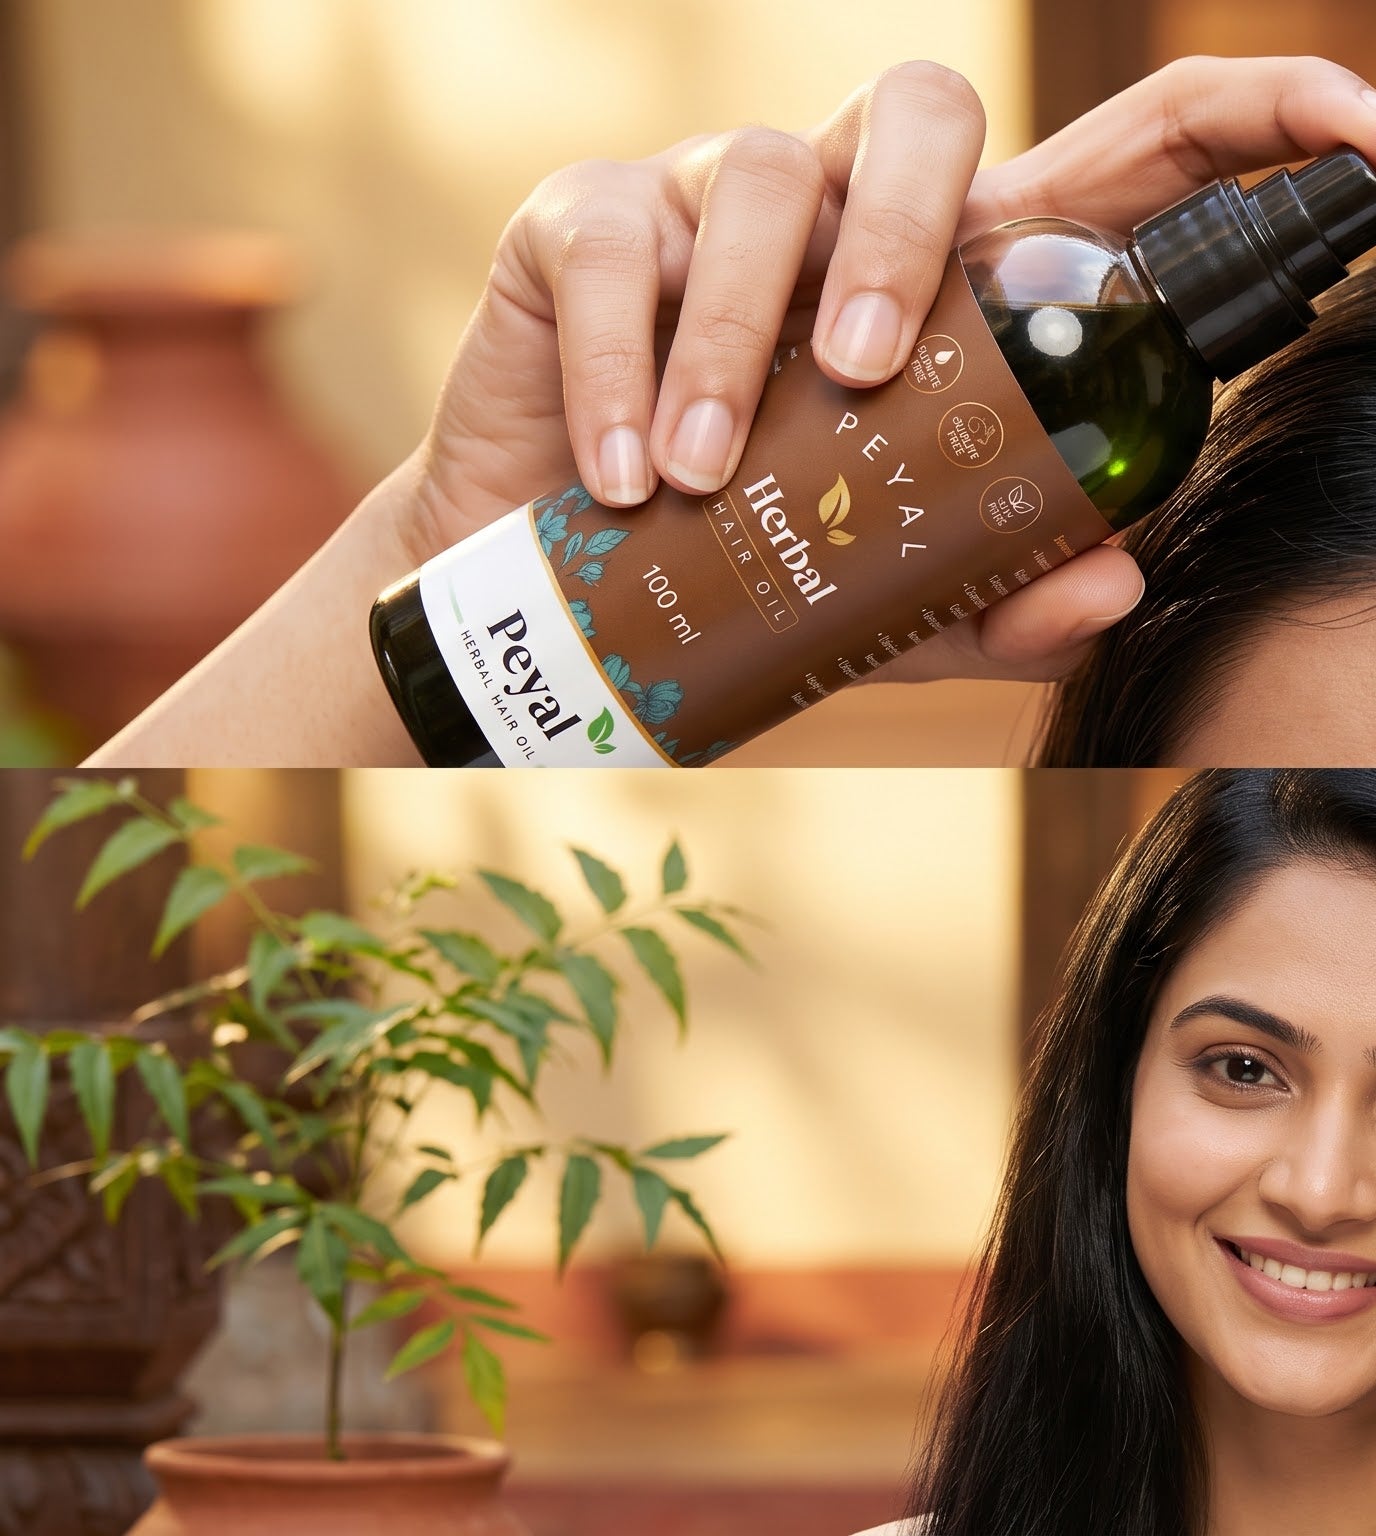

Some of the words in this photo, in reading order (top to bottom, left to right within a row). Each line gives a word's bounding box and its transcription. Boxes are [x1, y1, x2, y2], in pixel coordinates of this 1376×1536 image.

[835, 411, 927, 558] PEYAL
[947, 430, 965, 457] FREE
[642, 564, 678, 609] 100
[668, 613, 701, 645] ml
[712, 501, 752, 563] HAIR
[756, 582, 786, 621] OIL
[743, 472, 838, 606] Herbal
[461, 629, 492, 689] HERBAL
[491, 694, 518, 731] HAIR
[516, 736, 535, 761] OIL
[486, 608, 582, 742] Peyal
